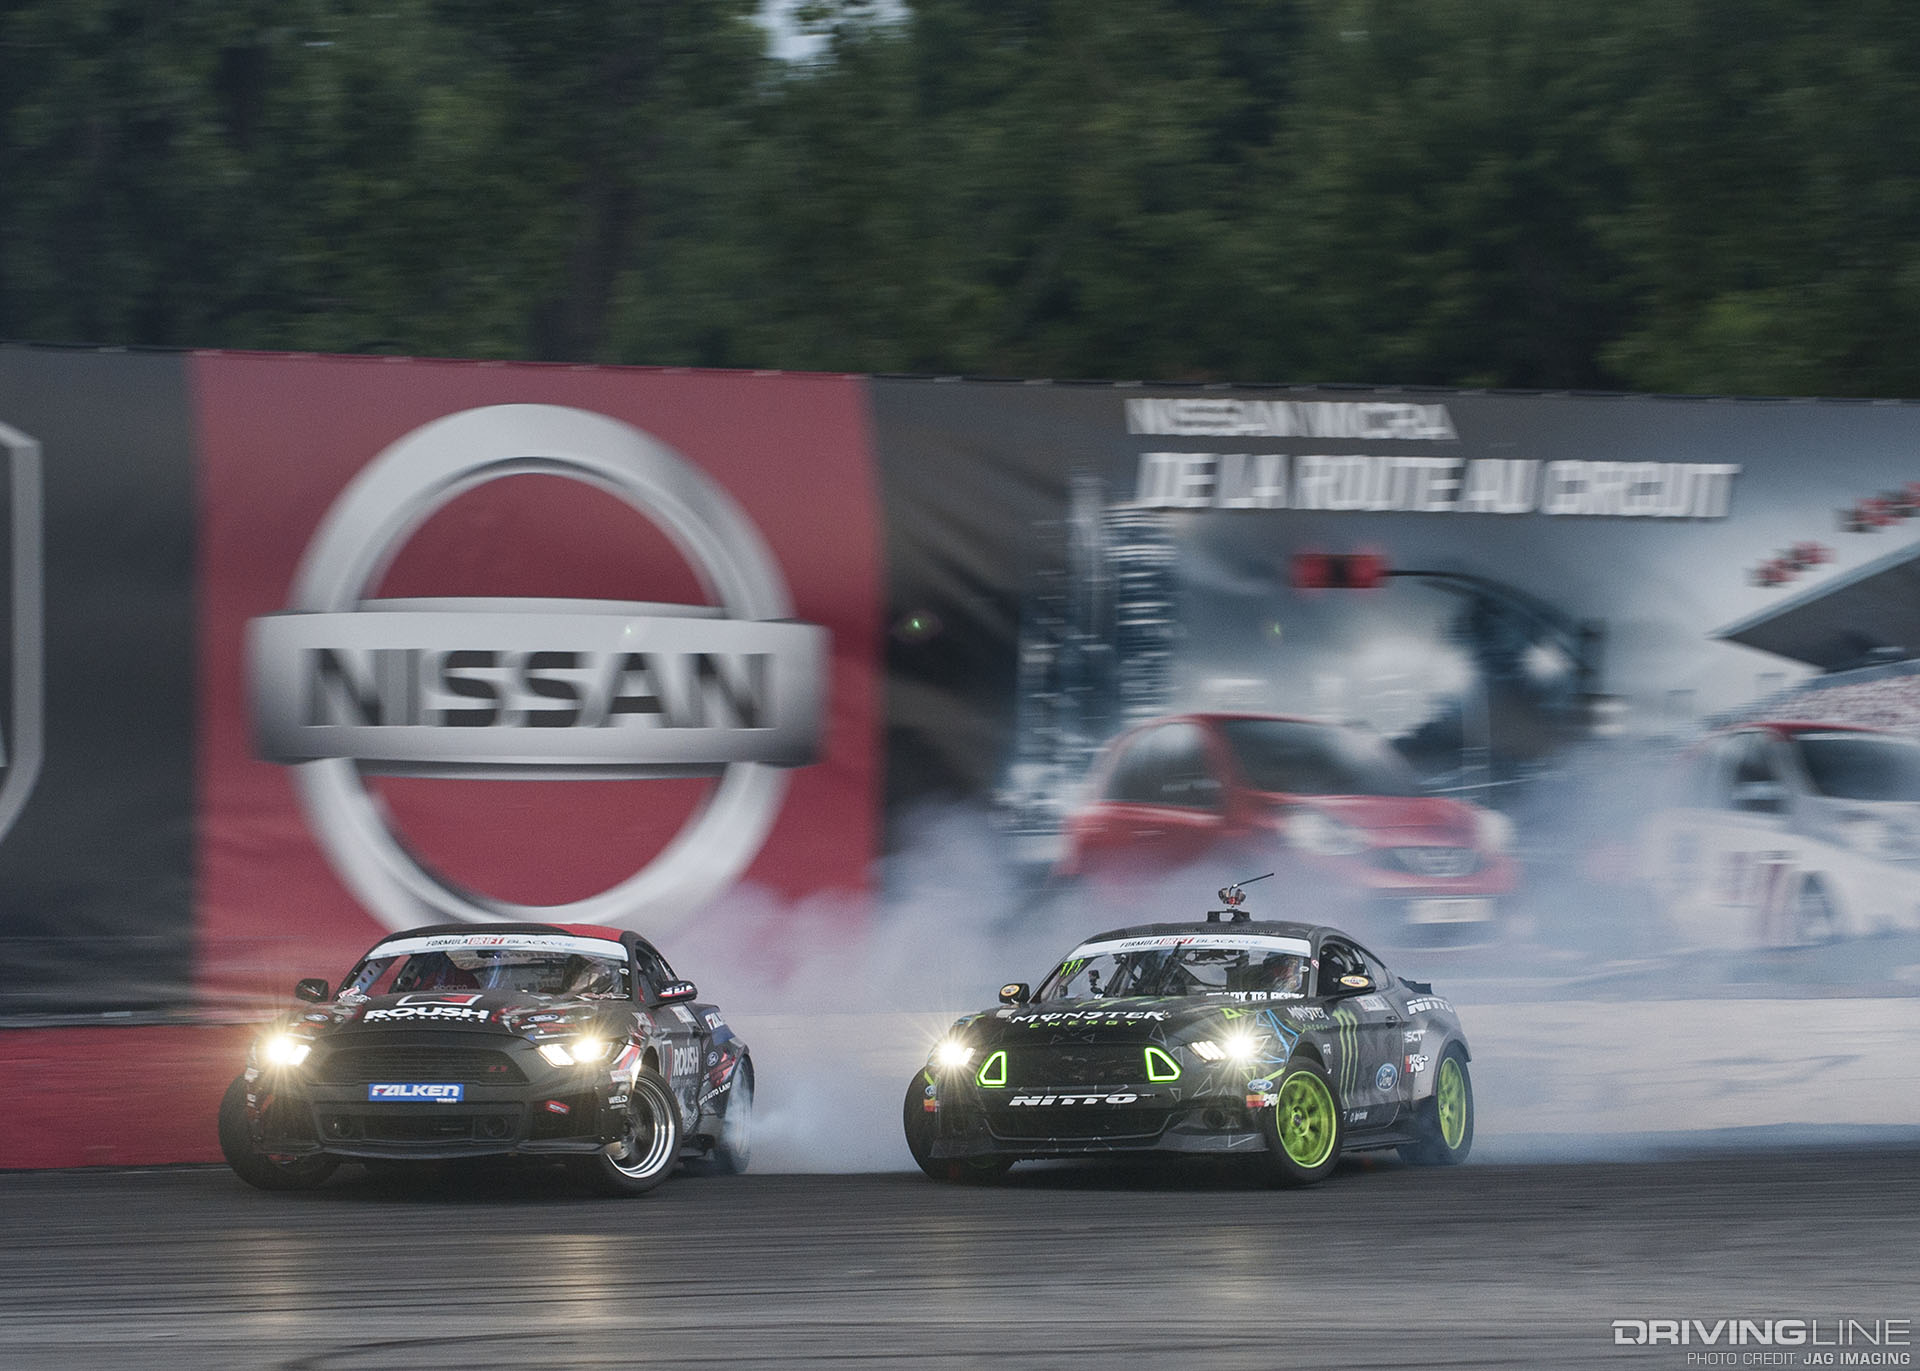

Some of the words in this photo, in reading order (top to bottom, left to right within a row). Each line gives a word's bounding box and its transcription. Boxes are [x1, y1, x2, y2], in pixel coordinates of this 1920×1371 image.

[1137, 453, 1216, 508] DE
[1217, 454, 1289, 510] LA
[1290, 455, 1464, 513] ROUTE
[1455, 459, 1546, 515] AU
[1541, 460, 1743, 519] CIRCUIT
[302, 648, 776, 728] NISSAN
[364, 1007, 489, 1020] ROUSH
[1011, 1011, 1172, 1023] MONSTER
[1029, 1020, 1137, 1029] ENERGY
[673, 1046, 699, 1076] ROUSH
[372, 1084, 460, 1097] FALKEN
[1009, 1094, 1138, 1106] NITTO
